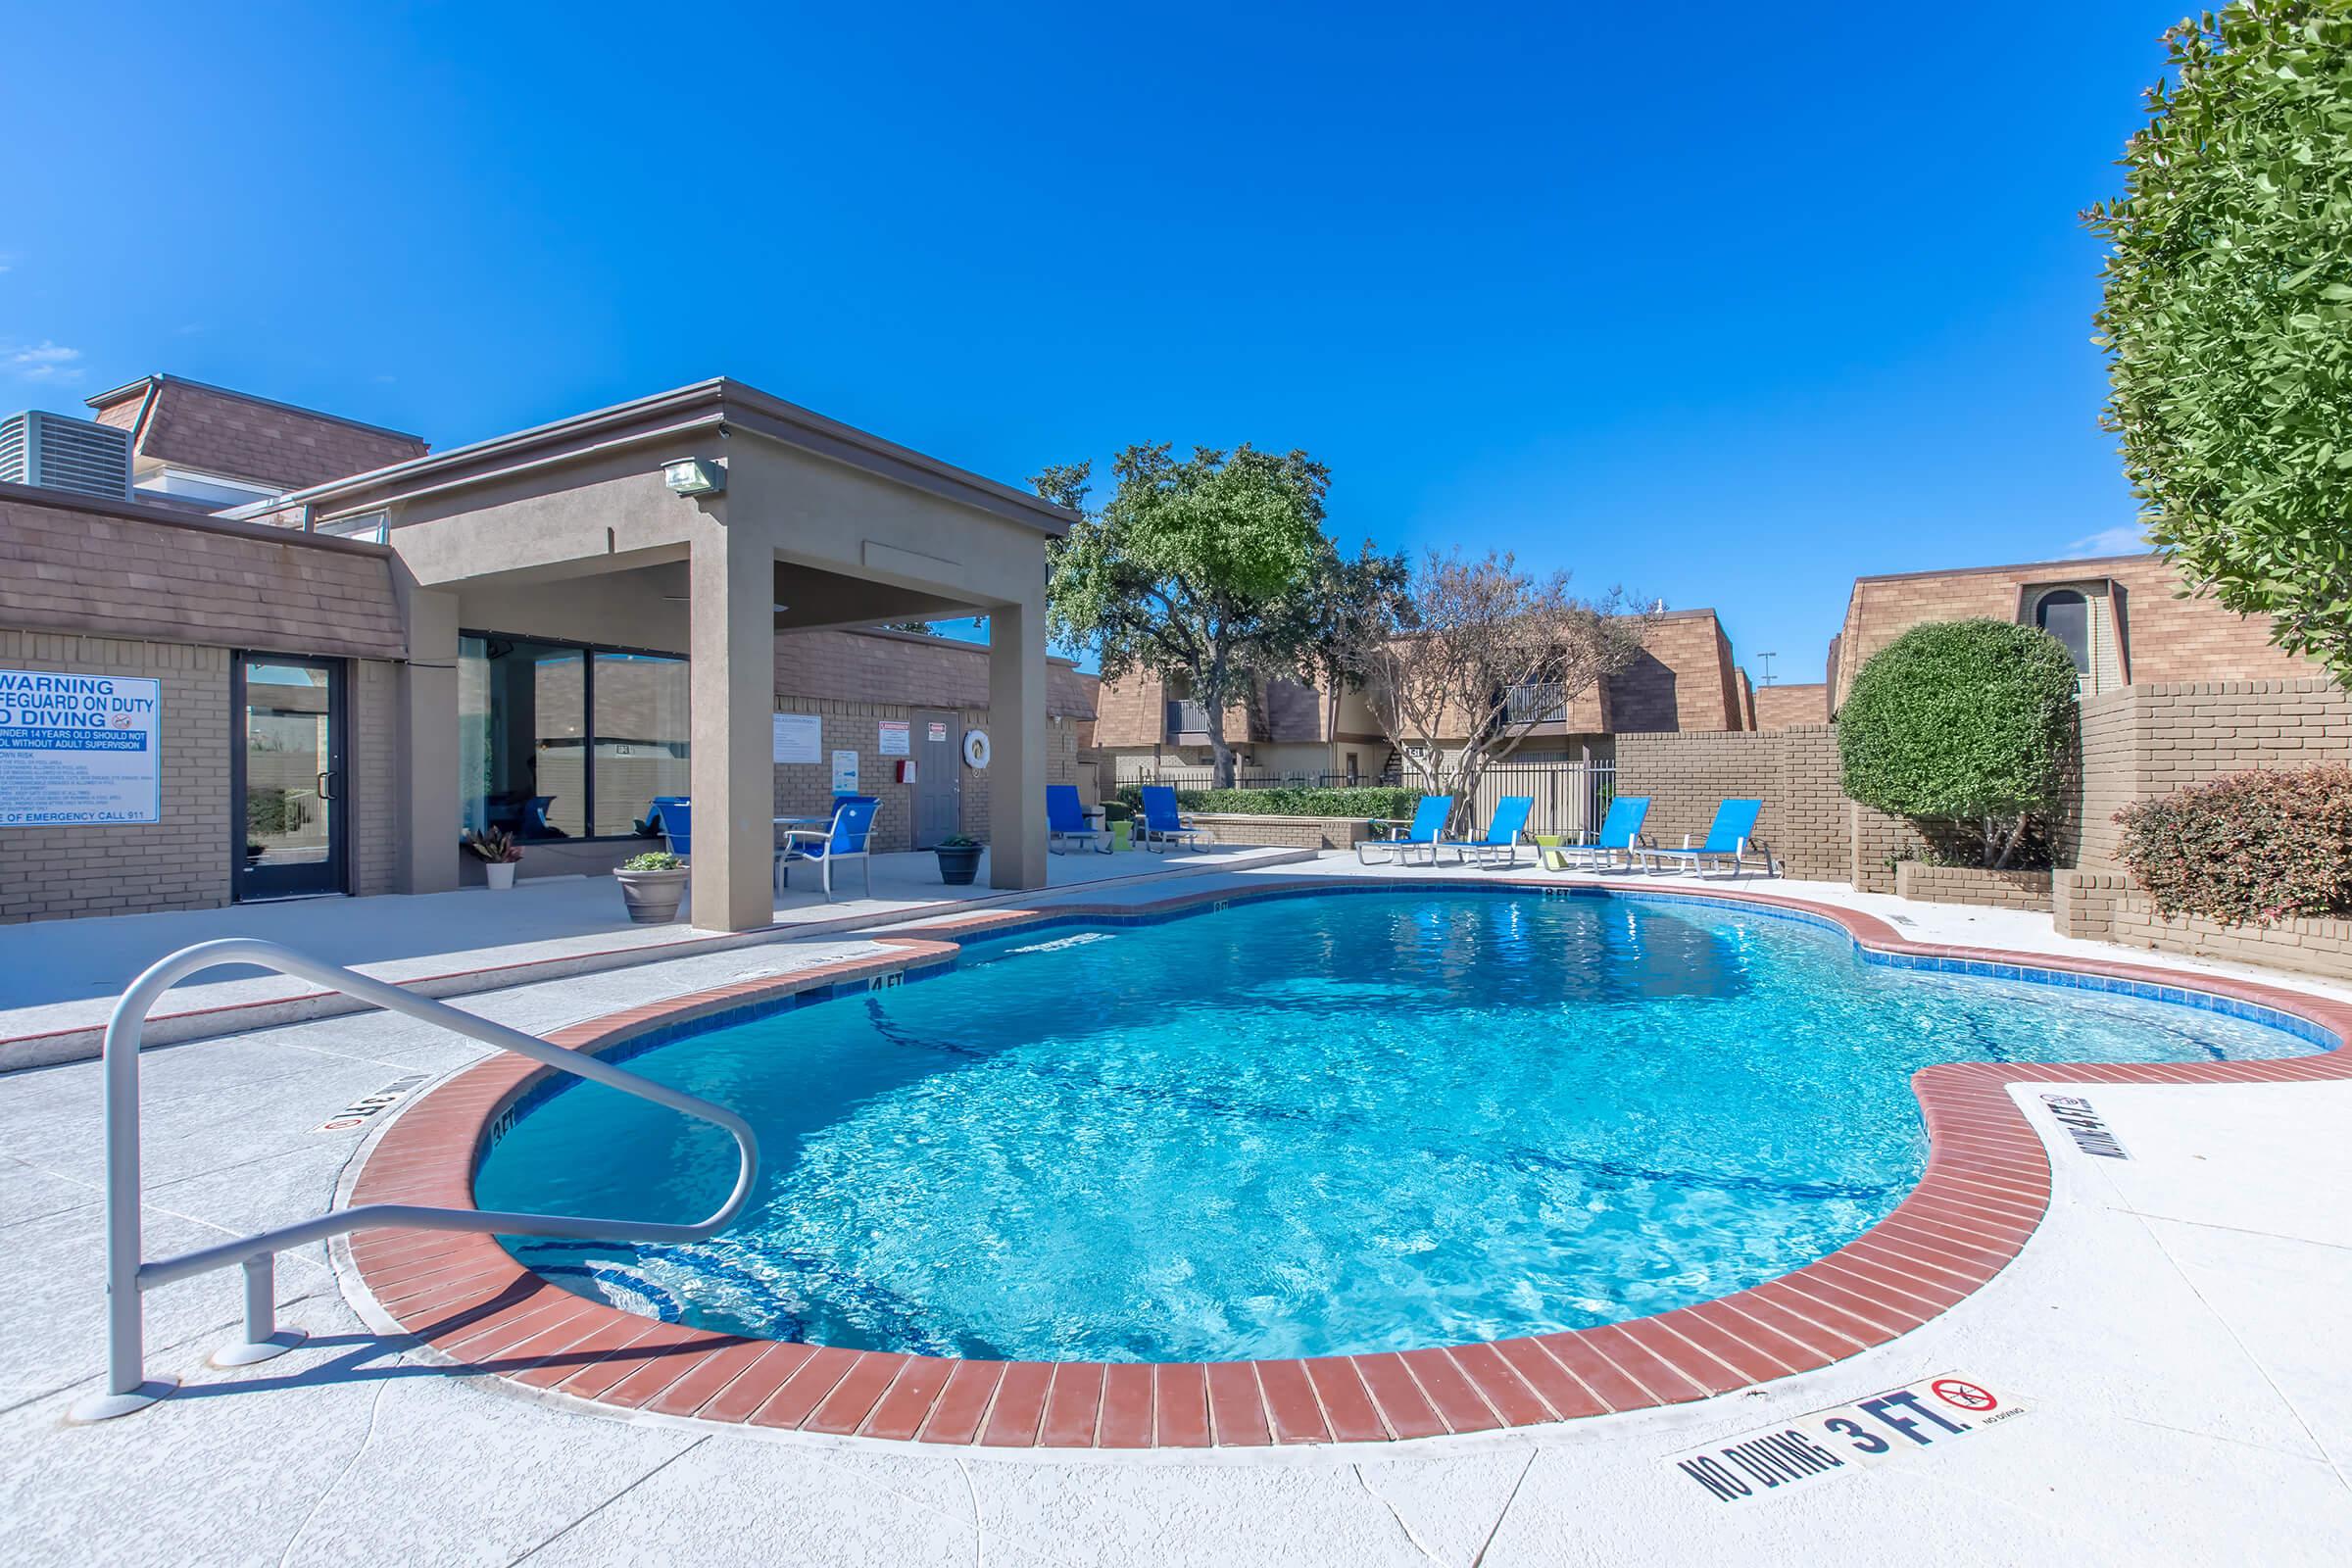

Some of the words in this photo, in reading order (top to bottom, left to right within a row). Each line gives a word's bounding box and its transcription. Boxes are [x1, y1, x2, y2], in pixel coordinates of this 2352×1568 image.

[83, 696, 107, 711] ON
[112, 697, 154, 713] DUTY
[22, 710, 106, 727] DIVING
[73, 730, 91, 739] OLD
[93, 731, 127, 740] SHOULD
[12, 738, 53, 748] WITHOUT
[55, 740, 83, 749] ADULT
[85, 741, 140, 750] SUPERVISION
[8, 813, 23, 822] OF
[26, 811, 95, 822] EMERGENCY
[98, 811, 125, 820] CALL
[127, 810, 144, 819] 911
[1982, 1416, 1998, 1427] NO
[1677, 1454, 1753, 1502] NO
[1720, 1429, 1845, 1489] DIVING
[1824, 1417, 1890, 1454] 3
